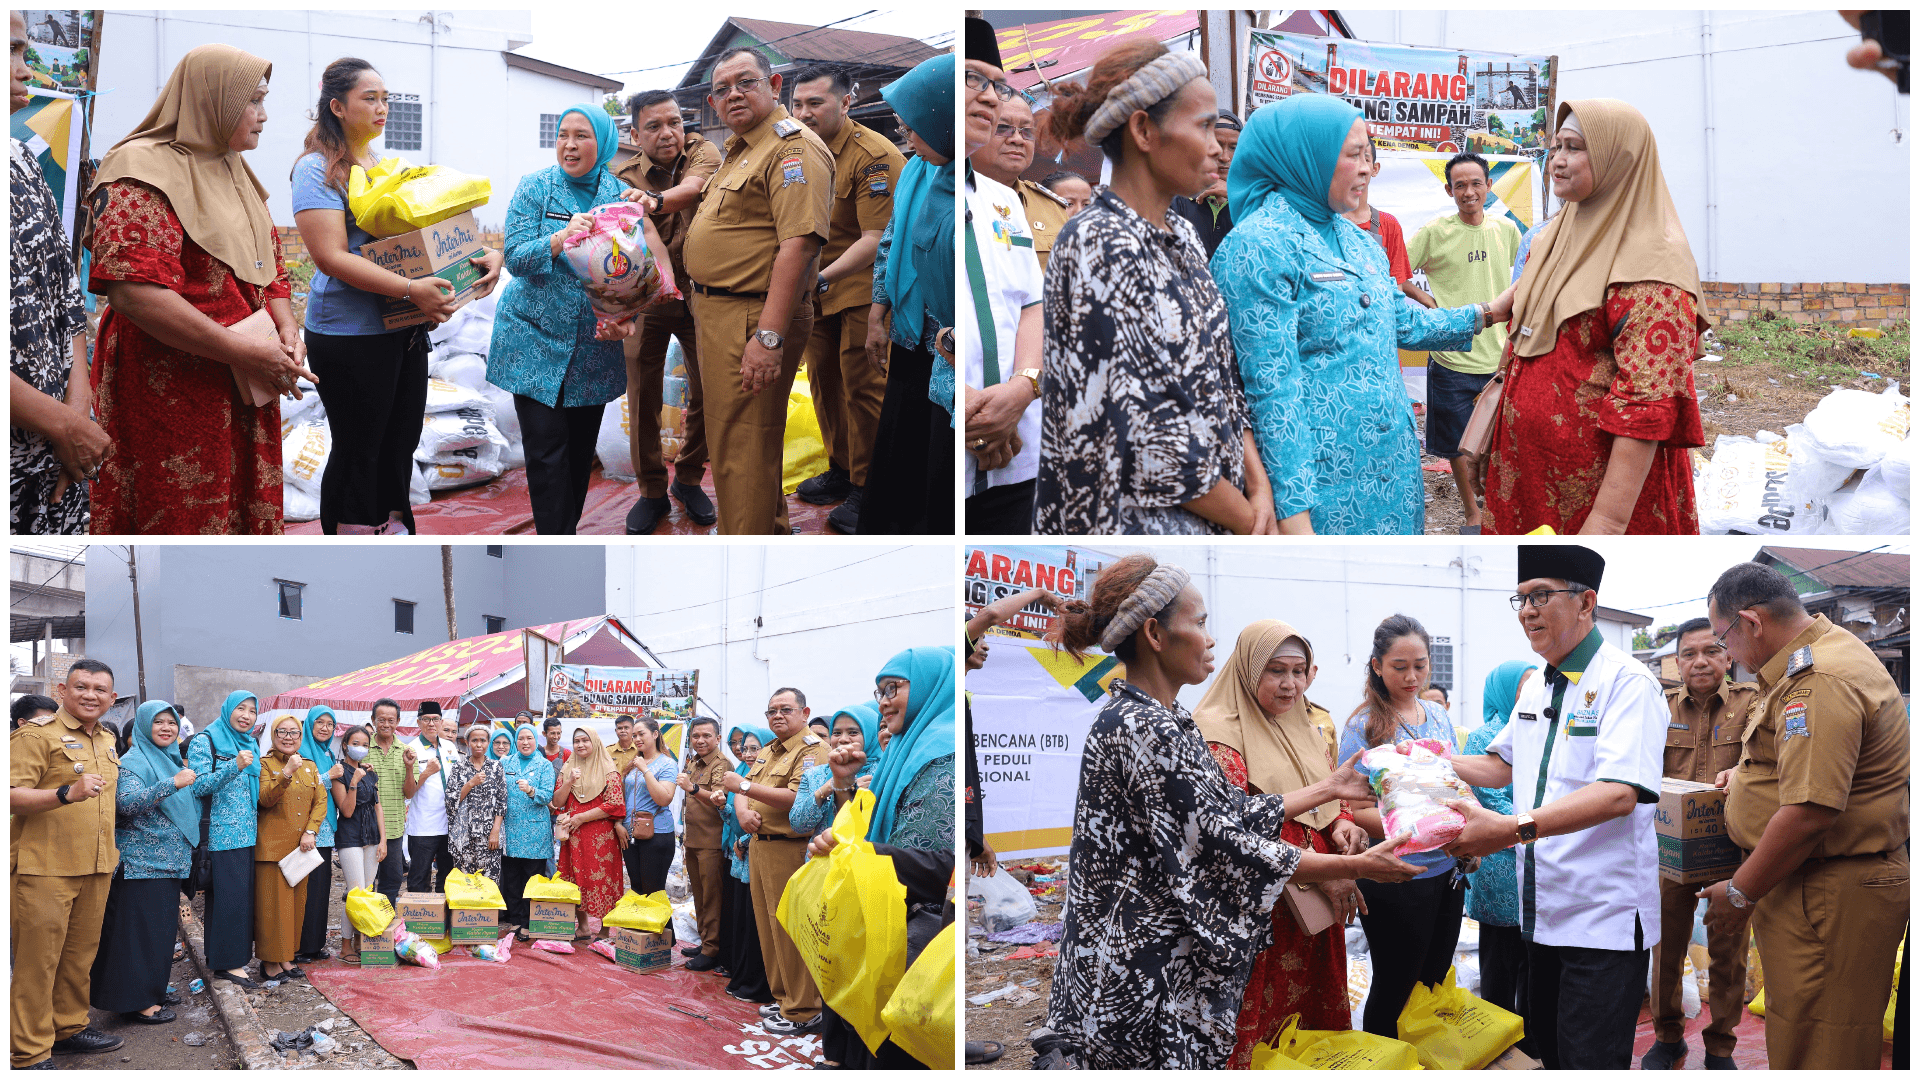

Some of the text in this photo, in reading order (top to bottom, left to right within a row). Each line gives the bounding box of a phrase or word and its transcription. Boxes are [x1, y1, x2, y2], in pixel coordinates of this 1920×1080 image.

[1257, 82, 1288, 94] DILARANG
[1329, 67, 1467, 101] DILARANG
[1395, 101, 1471, 125] SAMPAH
[1368, 123, 1441, 139] TEMPAT INI!
[1467, 250, 1487, 263] GAP
[965, 549, 1075, 596] ARANG
[1023, 614, 1047, 630] INI!
[585, 679, 651, 694] DILARANG
[583, 694, 653, 705] BUANG SAMPAH
[973, 733, 1069, 751] BENCANA (BTB)
[984, 754, 1031, 766] PEDULI
[978, 771, 1031, 782] SIONAL
[1705, 824, 1718, 834] 40
